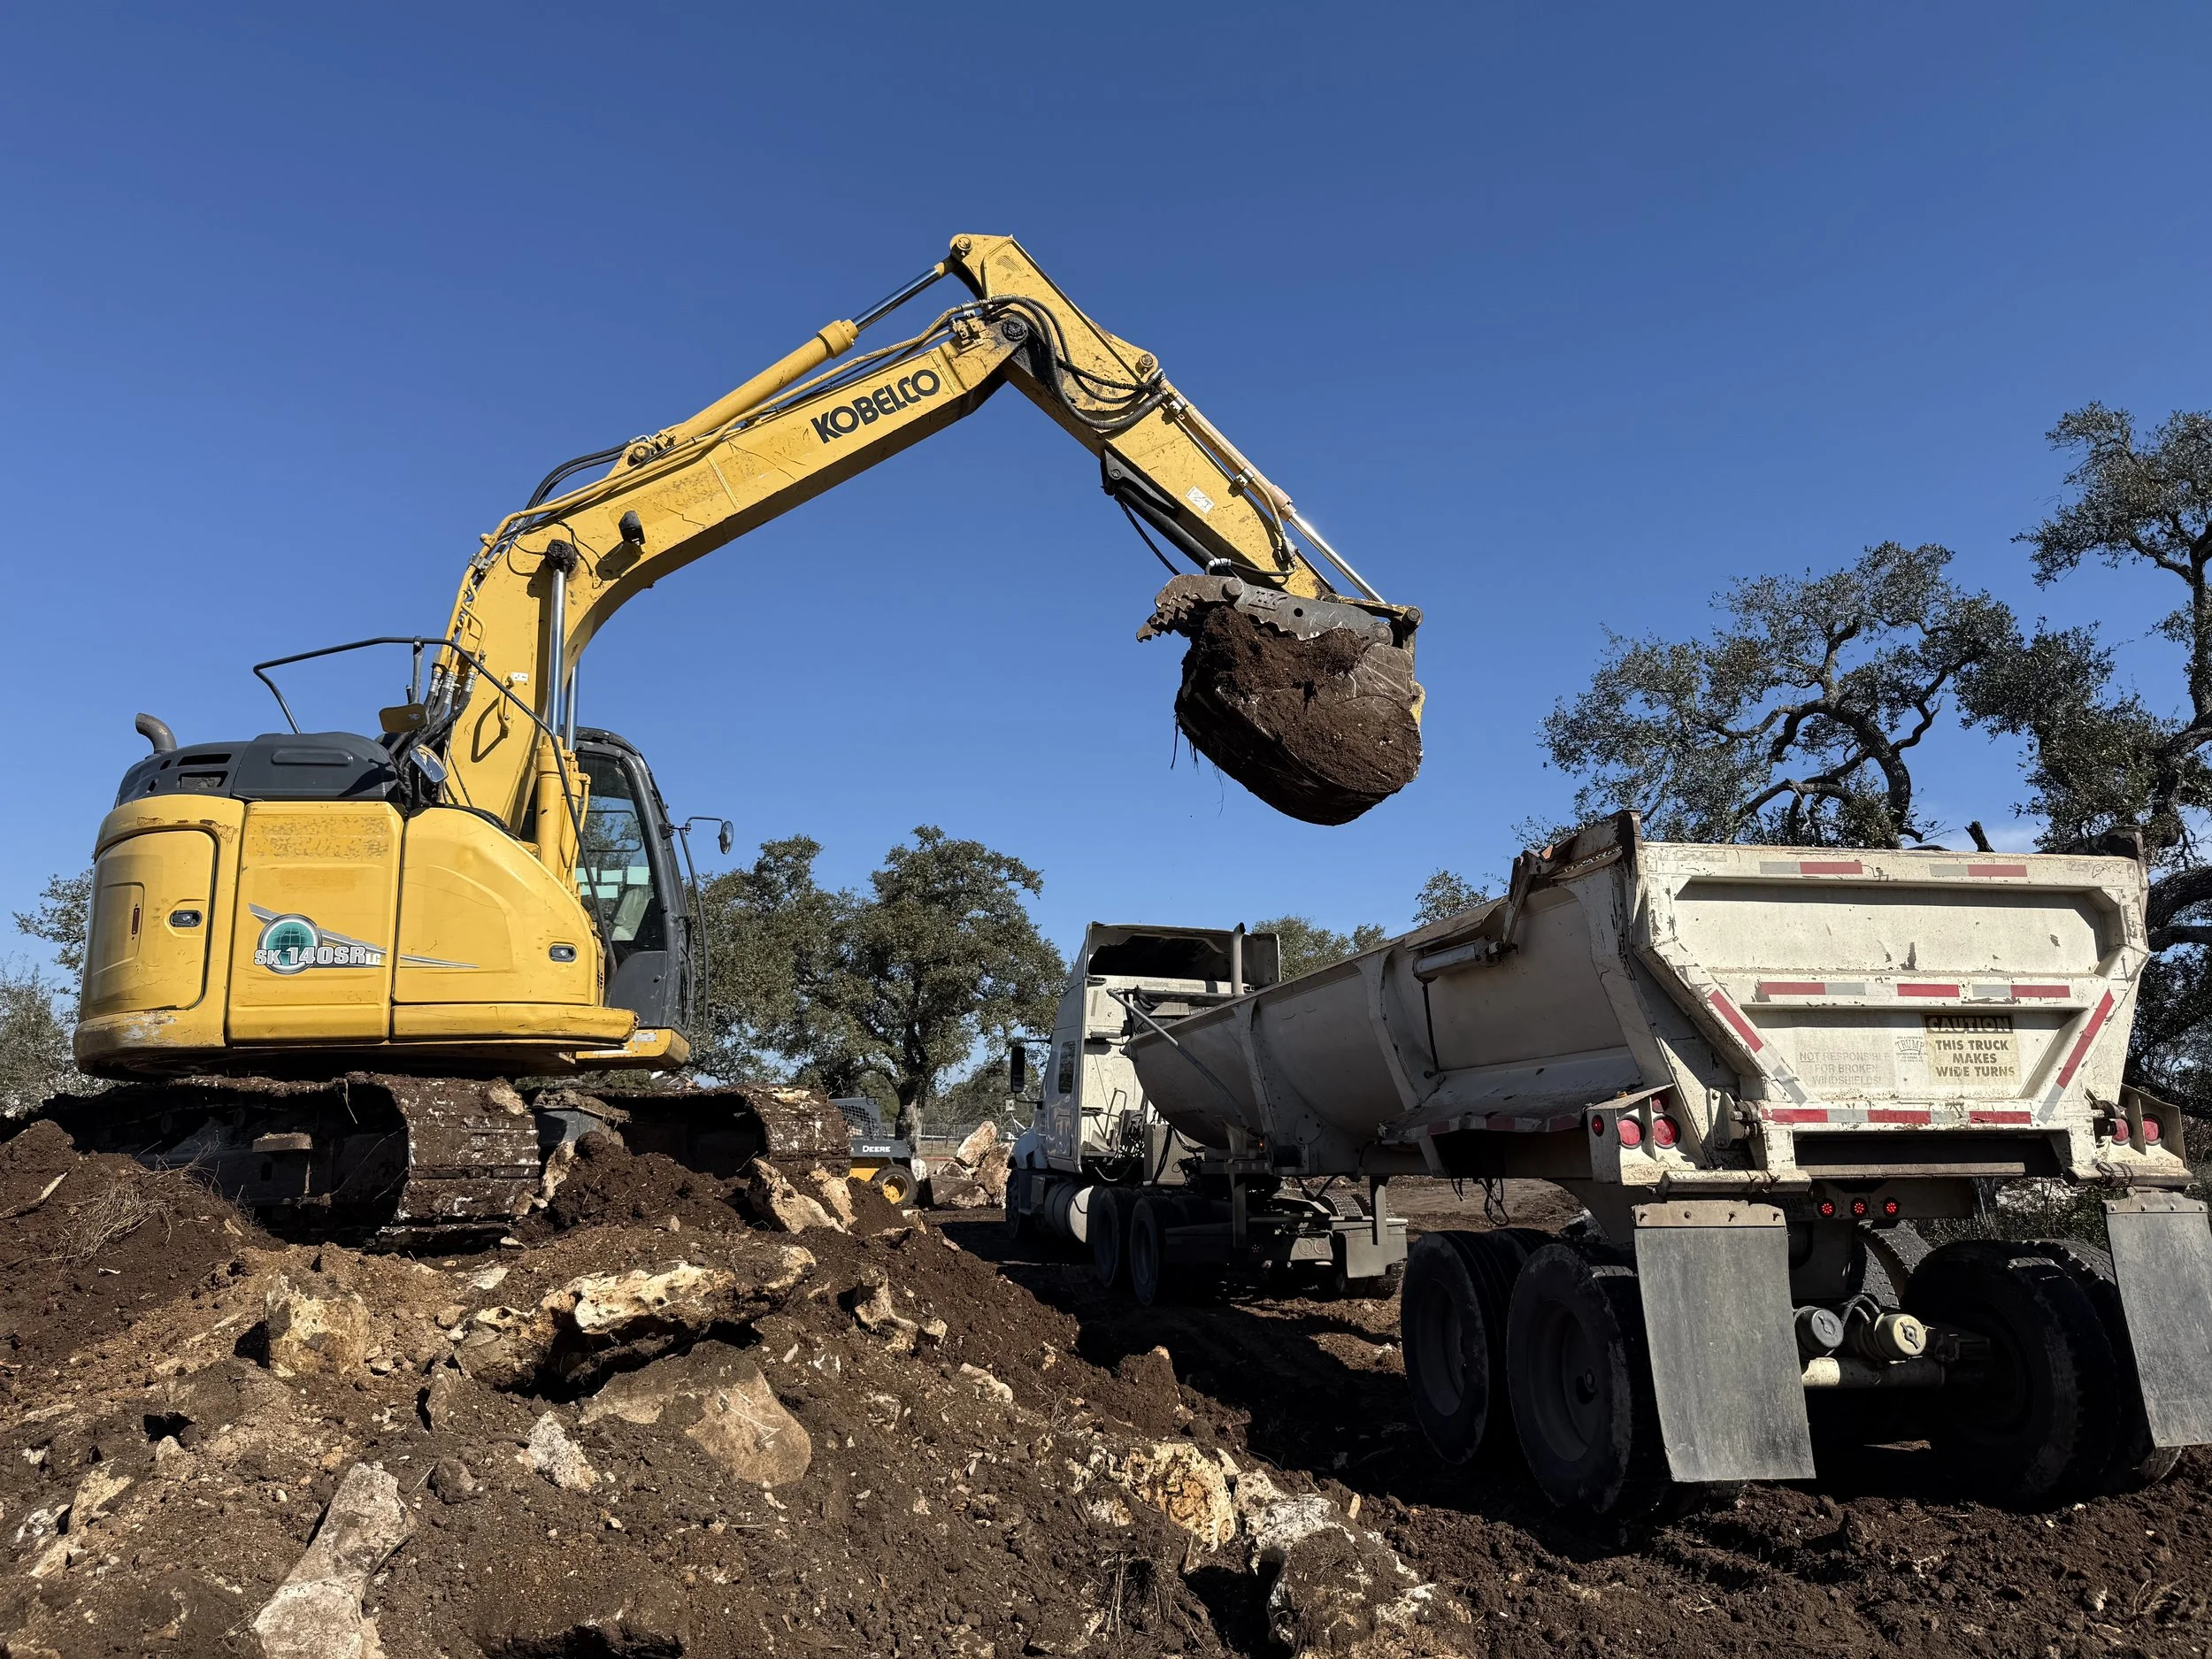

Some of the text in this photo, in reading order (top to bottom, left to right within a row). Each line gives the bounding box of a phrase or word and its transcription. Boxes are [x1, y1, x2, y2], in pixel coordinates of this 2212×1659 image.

[810, 369, 941, 444] KOBELCO
[254, 949, 282, 965] SK
[1928, 1018, 2010, 1032] CAUTION
[1894, 1039, 1925, 1051] TRUMP
[1935, 1040, 2009, 1051] THIS TRUCK
[1800, 1051, 1820, 1061] NOT
[1952, 1053, 1998, 1064] MAKES
[1815, 1064, 1878, 1073] FOR BROKEN
[1935, 1066, 2016, 1077] WIDE TURNS
